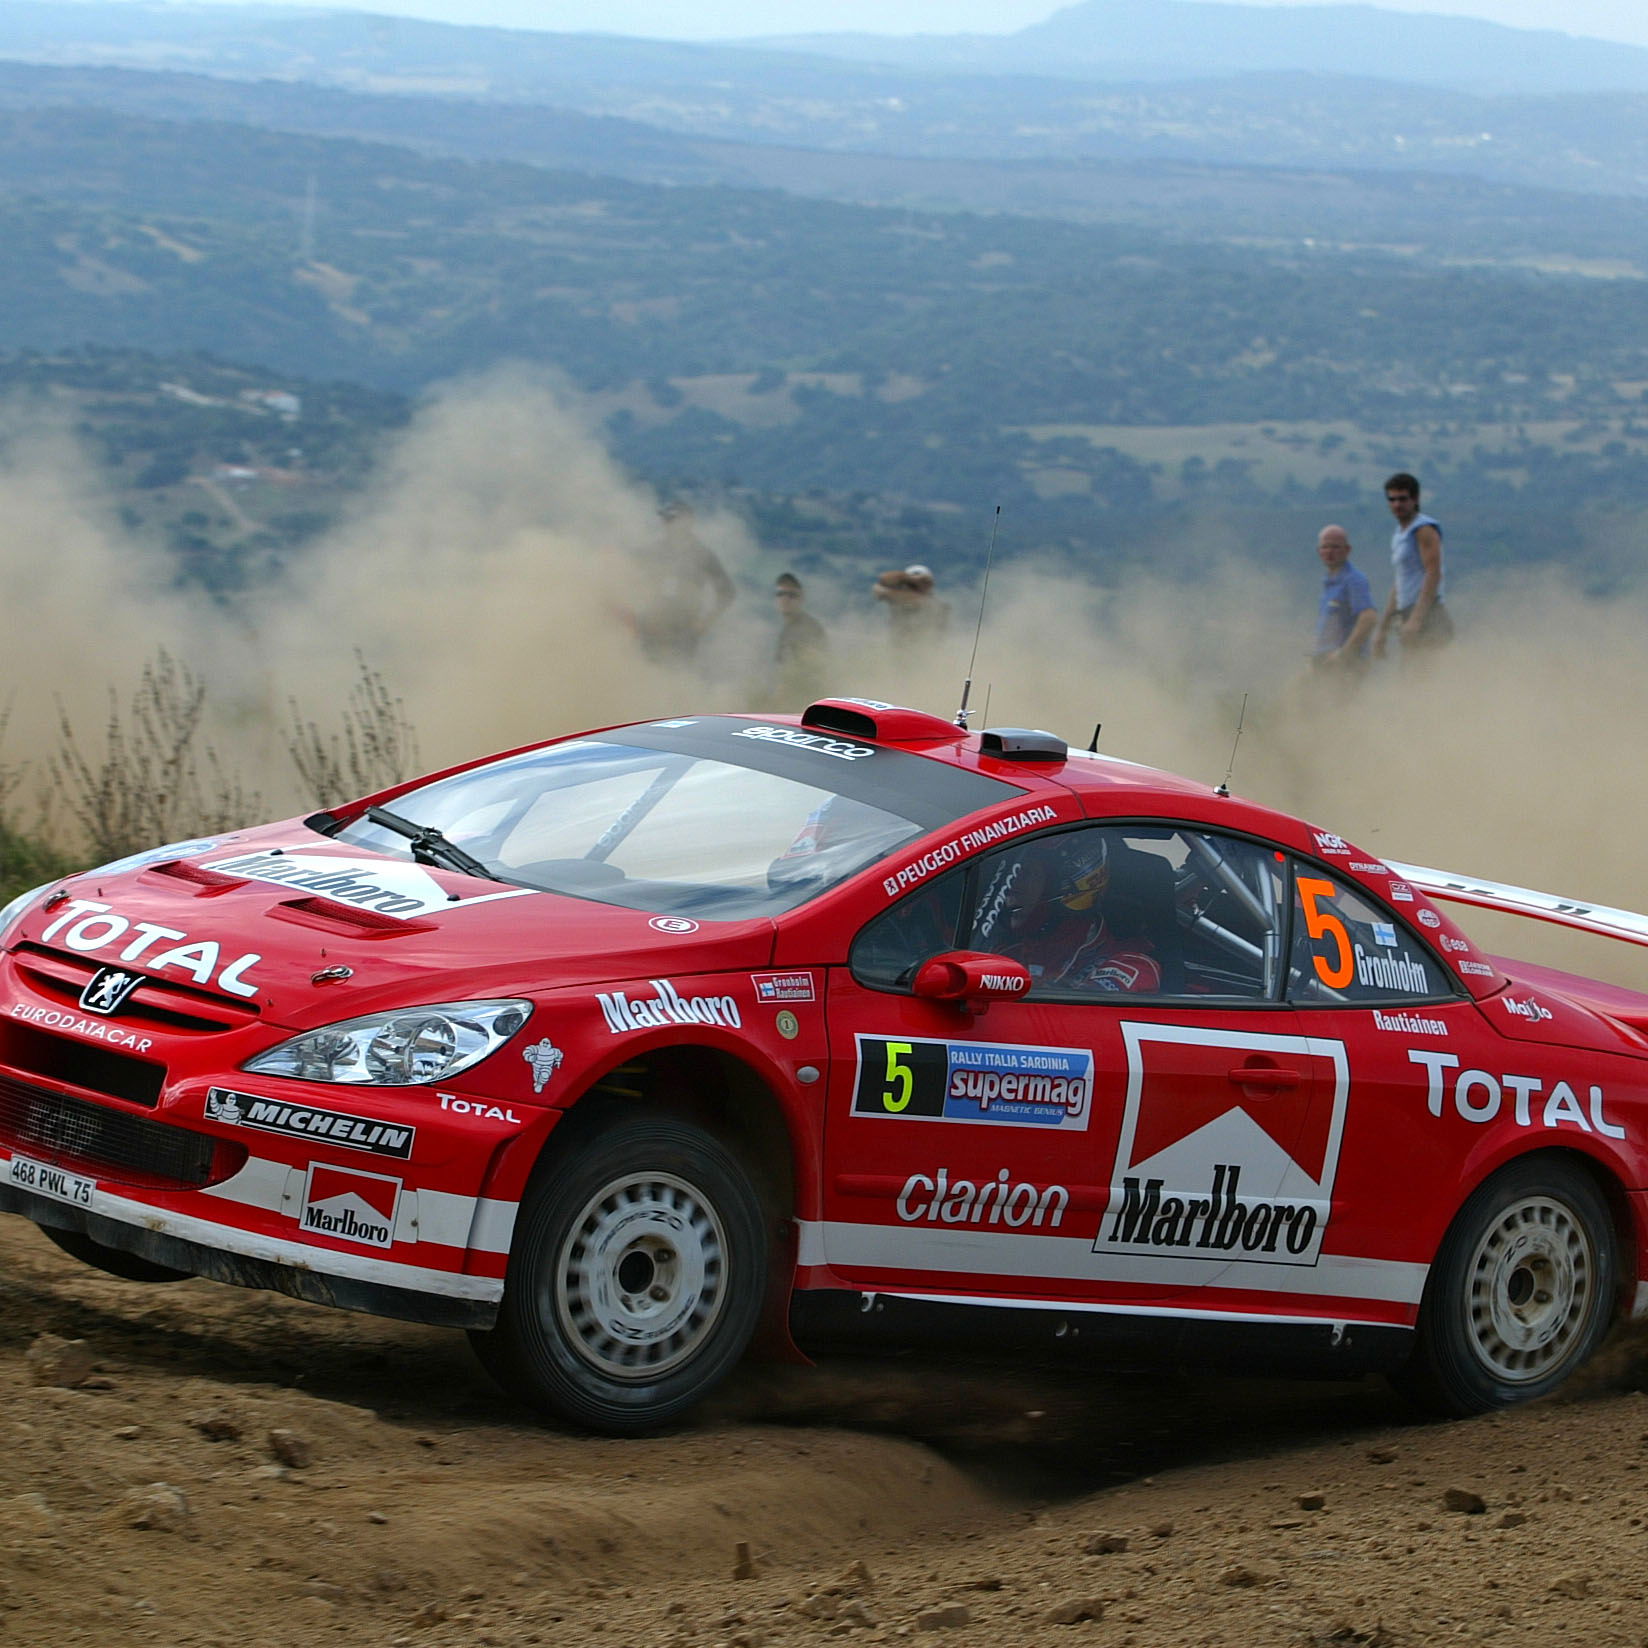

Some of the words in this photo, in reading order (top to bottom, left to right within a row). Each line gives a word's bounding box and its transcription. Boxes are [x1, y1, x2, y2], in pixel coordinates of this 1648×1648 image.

[740, 726, 875, 760] sparco
[896, 839, 962, 888] PEUGEOT
[960, 805, 1058, 852] FINANZIARIA
[1313, 832, 1348, 848] NGK
[208, 856, 426, 914] Marlboro
[41, 899, 263, 998] TOTAL
[1296, 876, 1355, 990] 5
[979, 974, 1024, 991] NIKKO
[1354, 943, 1429, 994] Gronholm
[10, 1003, 153, 1053] EURODATACAR
[595, 979, 742, 1034] Marlboro
[1371, 1009, 1449, 1036] Rautiainen
[1501, 997, 1553, 1022] Maisto
[882, 1041, 913, 1113] 5
[951, 1051, 983, 1064] RALLY
[985, 1053, 1019, 1067] ITALIA
[1020, 1055, 1070, 1071] SARDINIA
[436, 1093, 521, 1124] TOTAL
[950, 1070, 1086, 1114] supermag
[1407, 1049, 1626, 1140] TOTAL
[248, 1101, 410, 1149] MICHELIN
[12, 1160, 35, 1185] 468
[39, 1169, 68, 1197] PWL
[73, 1180, 92, 1203] 75
[896, 1168, 1070, 1228] clarion
[303, 1206, 390, 1243] Marlboro
[1108, 1164, 1319, 1255] Marlboro
